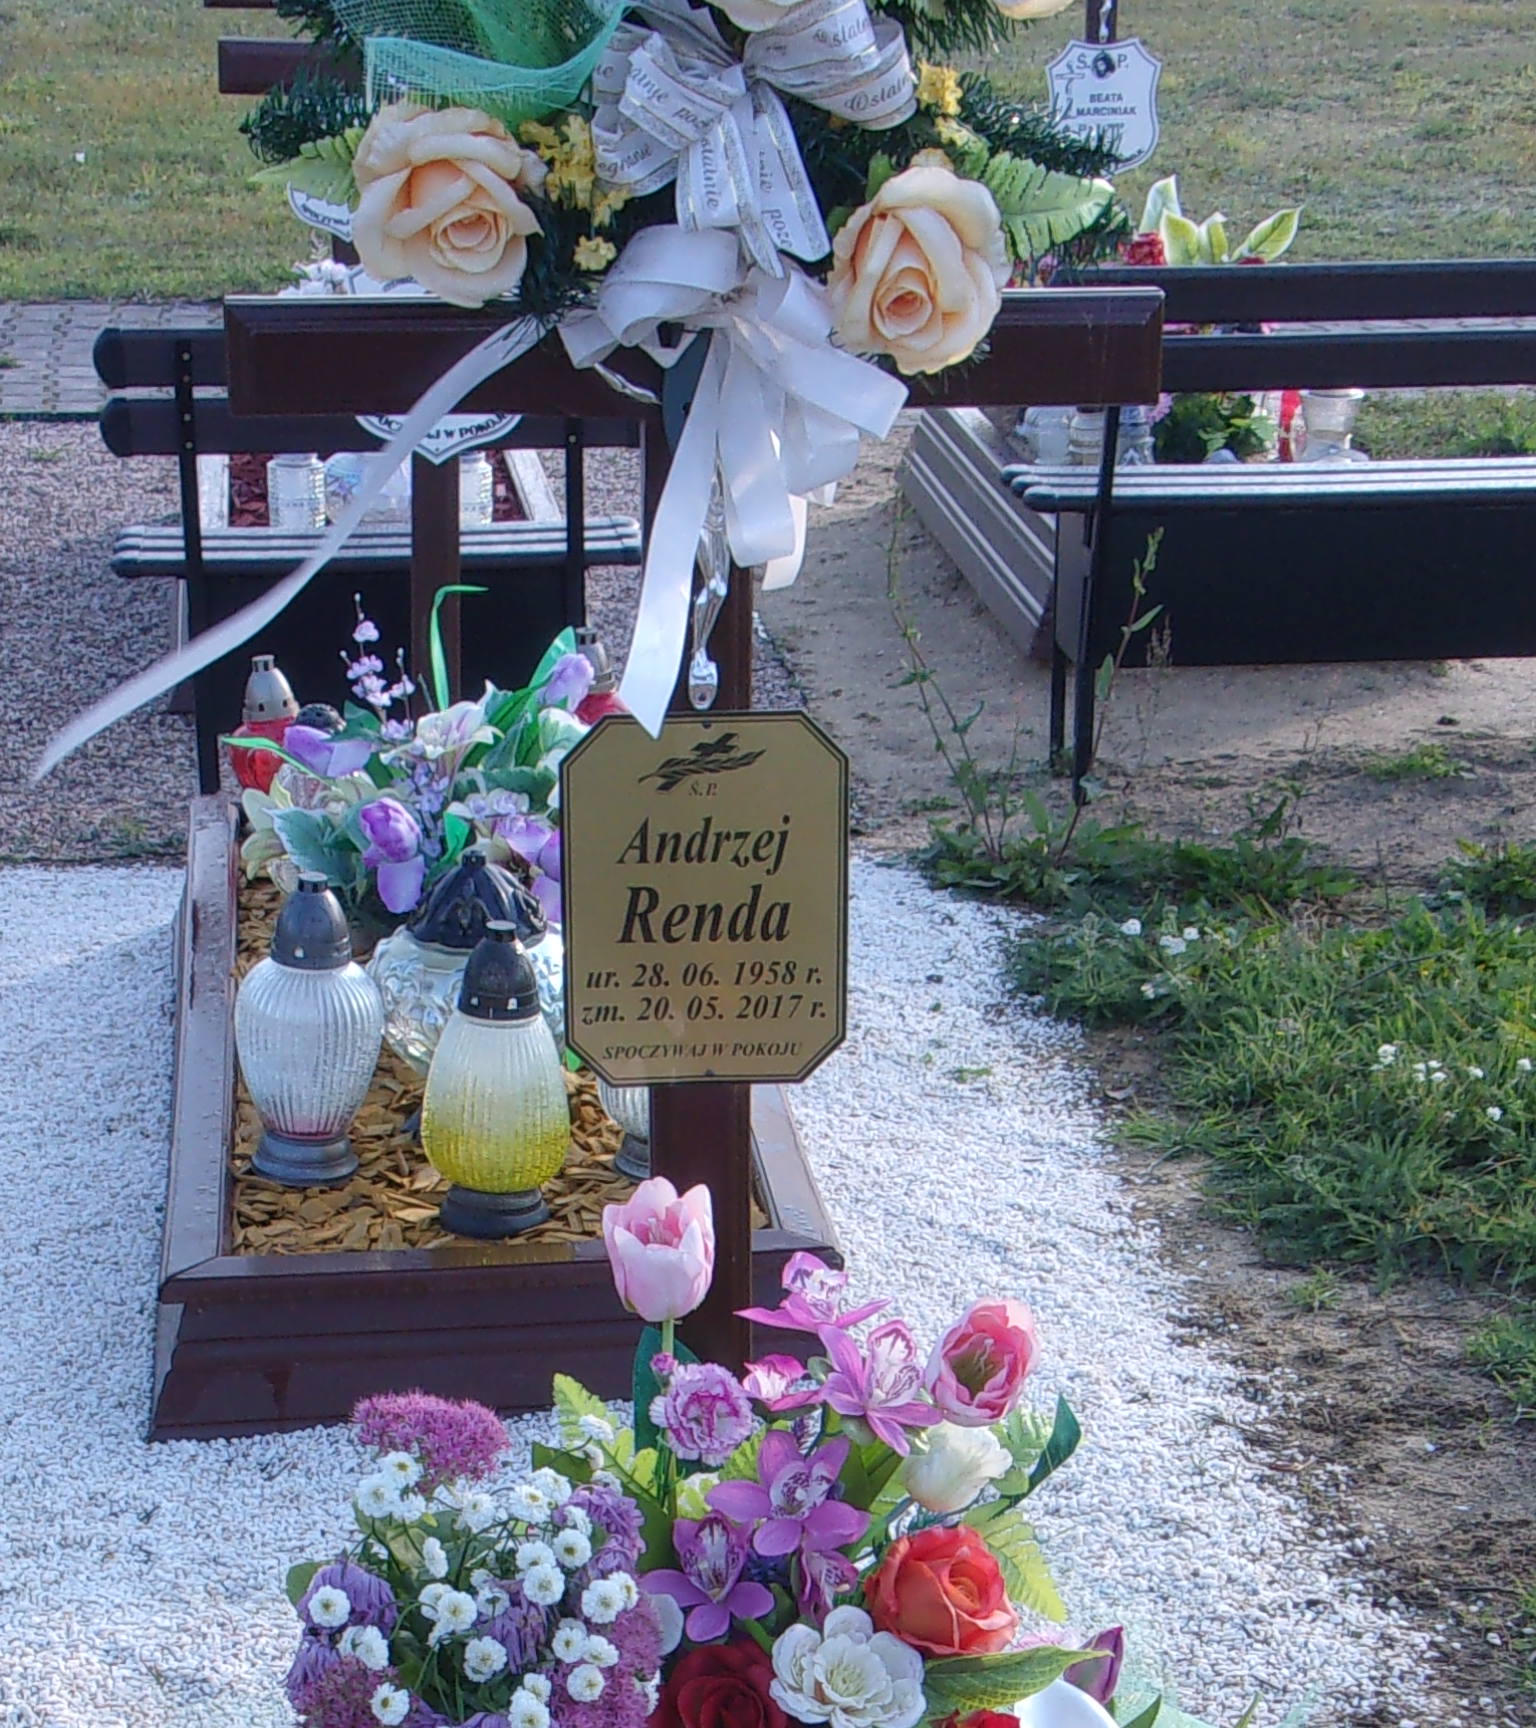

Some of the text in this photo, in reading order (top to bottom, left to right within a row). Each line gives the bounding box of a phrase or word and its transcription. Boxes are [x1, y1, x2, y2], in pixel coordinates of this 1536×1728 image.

[1076, 106, 1137, 116] MARCINIAK
[1089, 93, 1124, 104] BEATA
[616, 814, 791, 876] Andrzej
[615, 883, 792, 944] Renda
[585, 960, 824, 990] ur. 28. 06. 1958 r.
[581, 994, 827, 1026] zm. 20. 05. 2017 r.
[602, 1044, 708, 1060] SPOCZYWAJ
[731, 1040, 803, 1058] POKOJU
